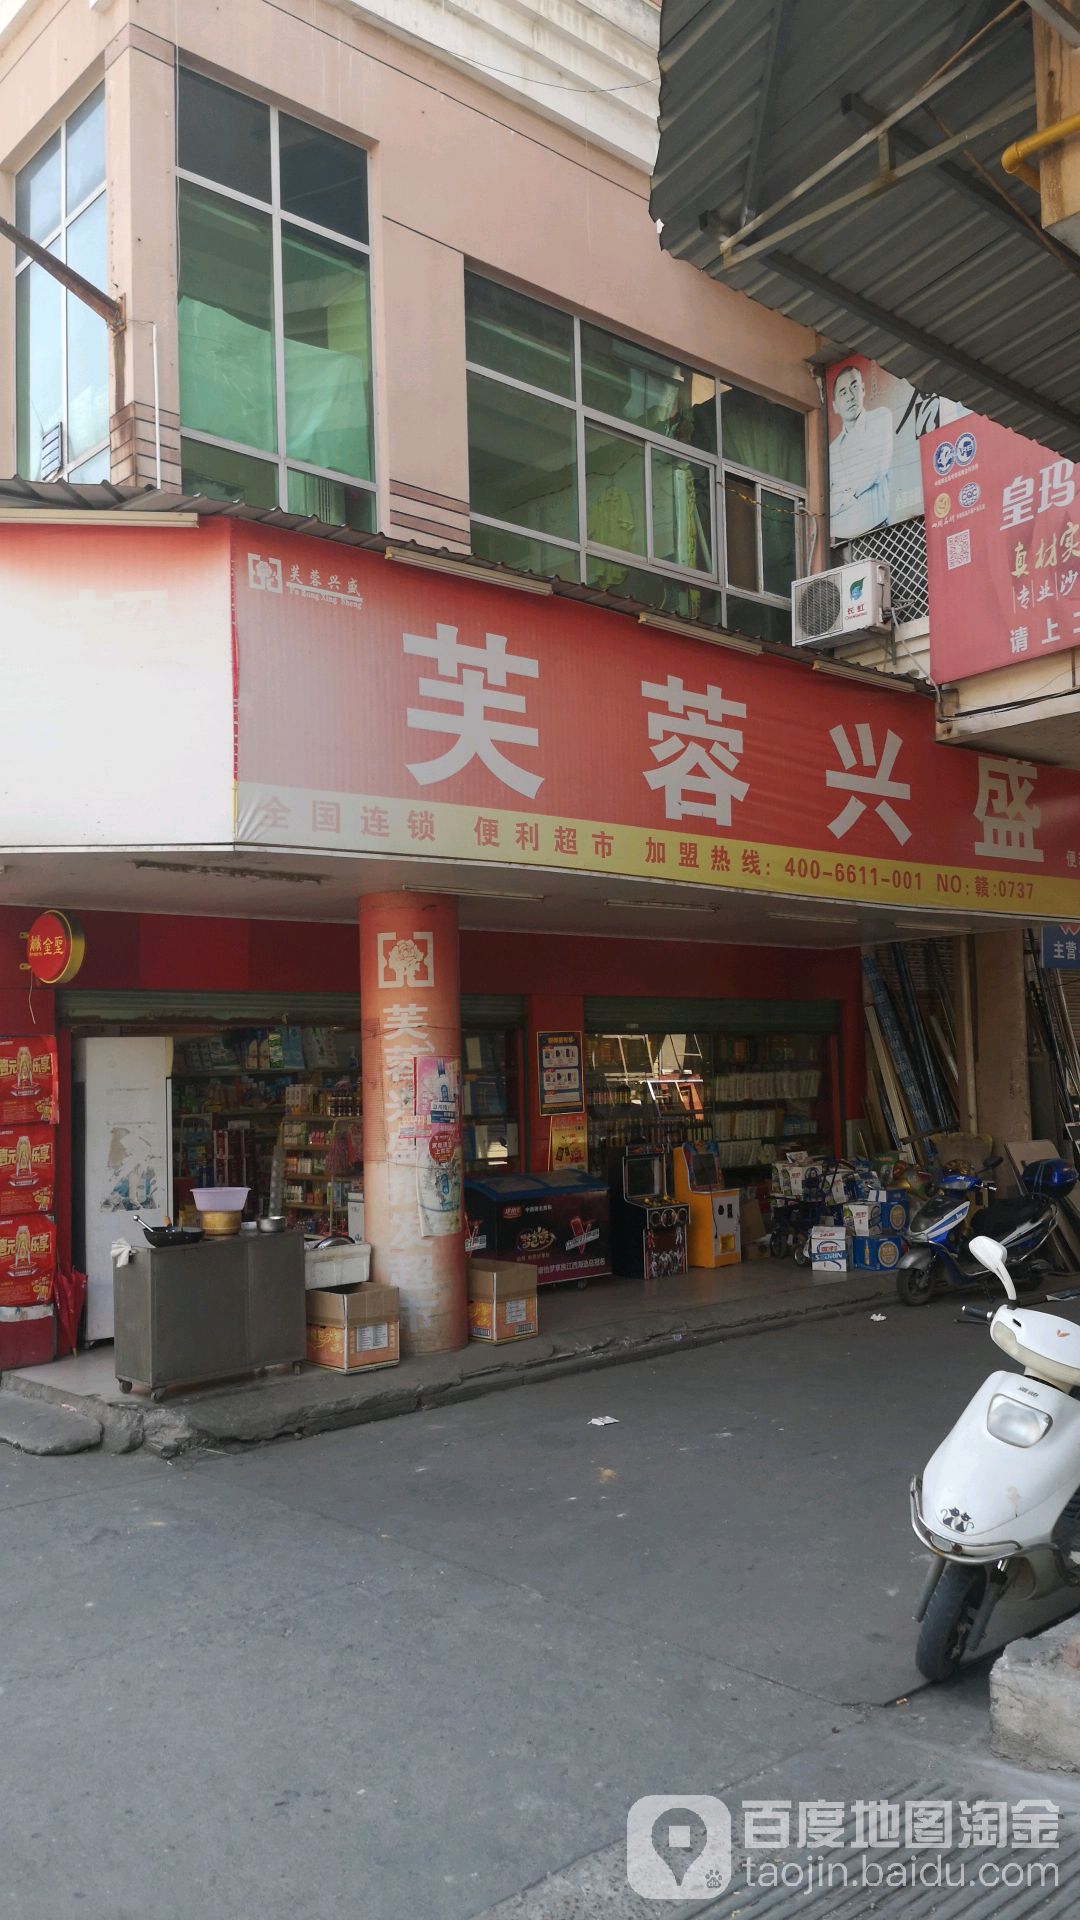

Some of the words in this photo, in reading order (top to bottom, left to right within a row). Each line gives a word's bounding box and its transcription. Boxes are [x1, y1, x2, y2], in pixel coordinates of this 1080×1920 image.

[1000, 460, 1076, 531] 皇玛
[289, 564, 361, 597] 芙蓉兴盛
[403, 622, 1044, 863] 芙蓉兴盛
[258, 796, 436, 842] 全国连锁
[473, 816, 614, 858] 便利超市
[1053, 941, 1077, 960] 主营
